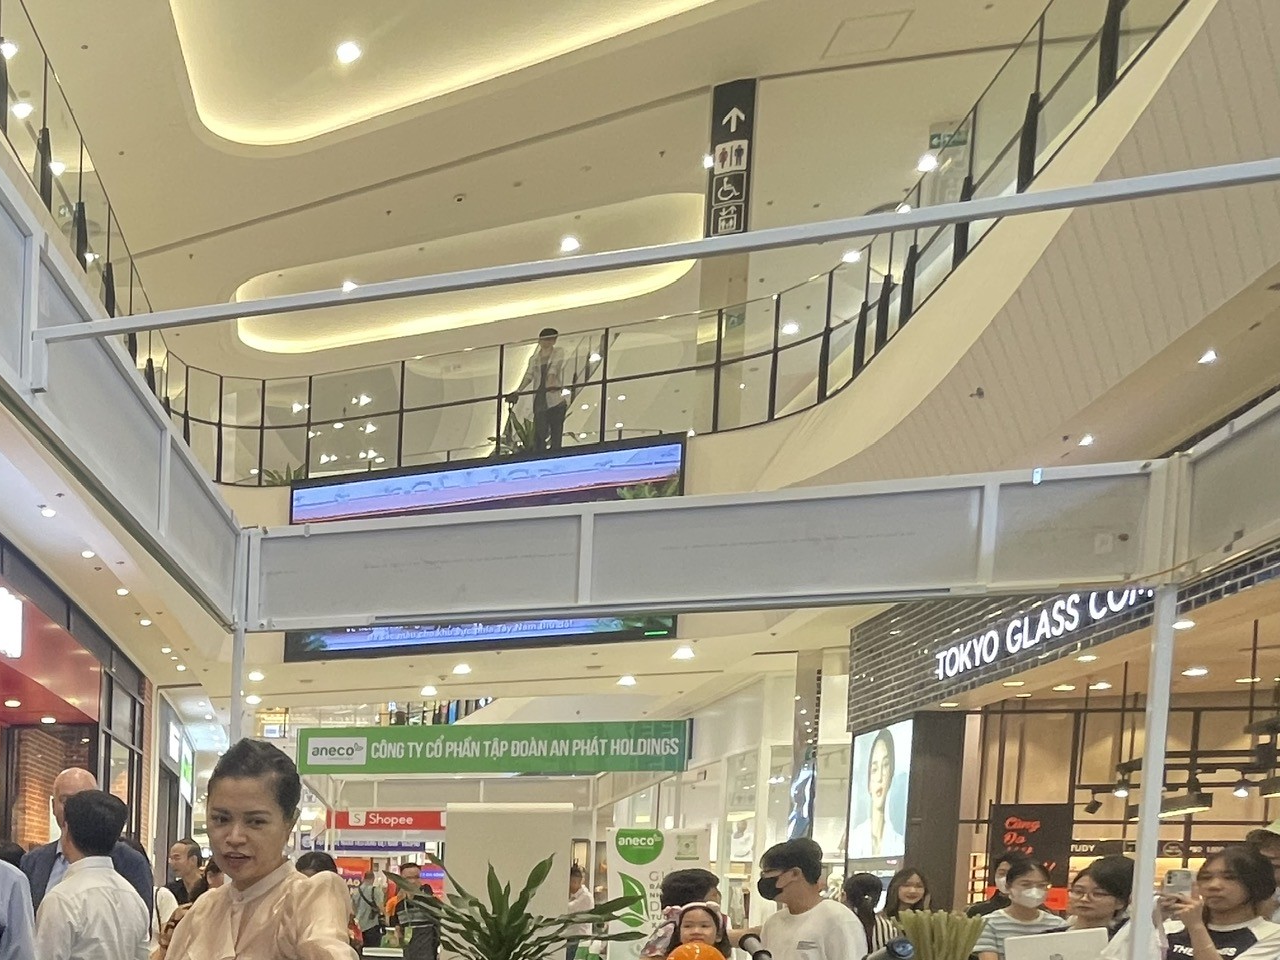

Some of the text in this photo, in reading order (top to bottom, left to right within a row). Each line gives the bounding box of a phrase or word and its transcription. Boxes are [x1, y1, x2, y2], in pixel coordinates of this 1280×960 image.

[934, 629, 1000, 681] TOKYO
[1005, 593, 1080, 654] GLASS
[311, 744, 356, 757] aneco
[371, 738, 405, 759] CÔNG
[408, 741, 422, 759] TY
[483, 737, 508, 760] TẬP
[511, 737, 548, 757] ĐOÀN
[549, 739, 570, 757] AN
[572, 736, 608, 757] PHÁT
[610, 737, 680, 756] HOLDINGS
[368, 813, 414, 827] Shopee
[618, 836, 655, 846] aneco
[1070, 844, 1095, 852] TUDY
